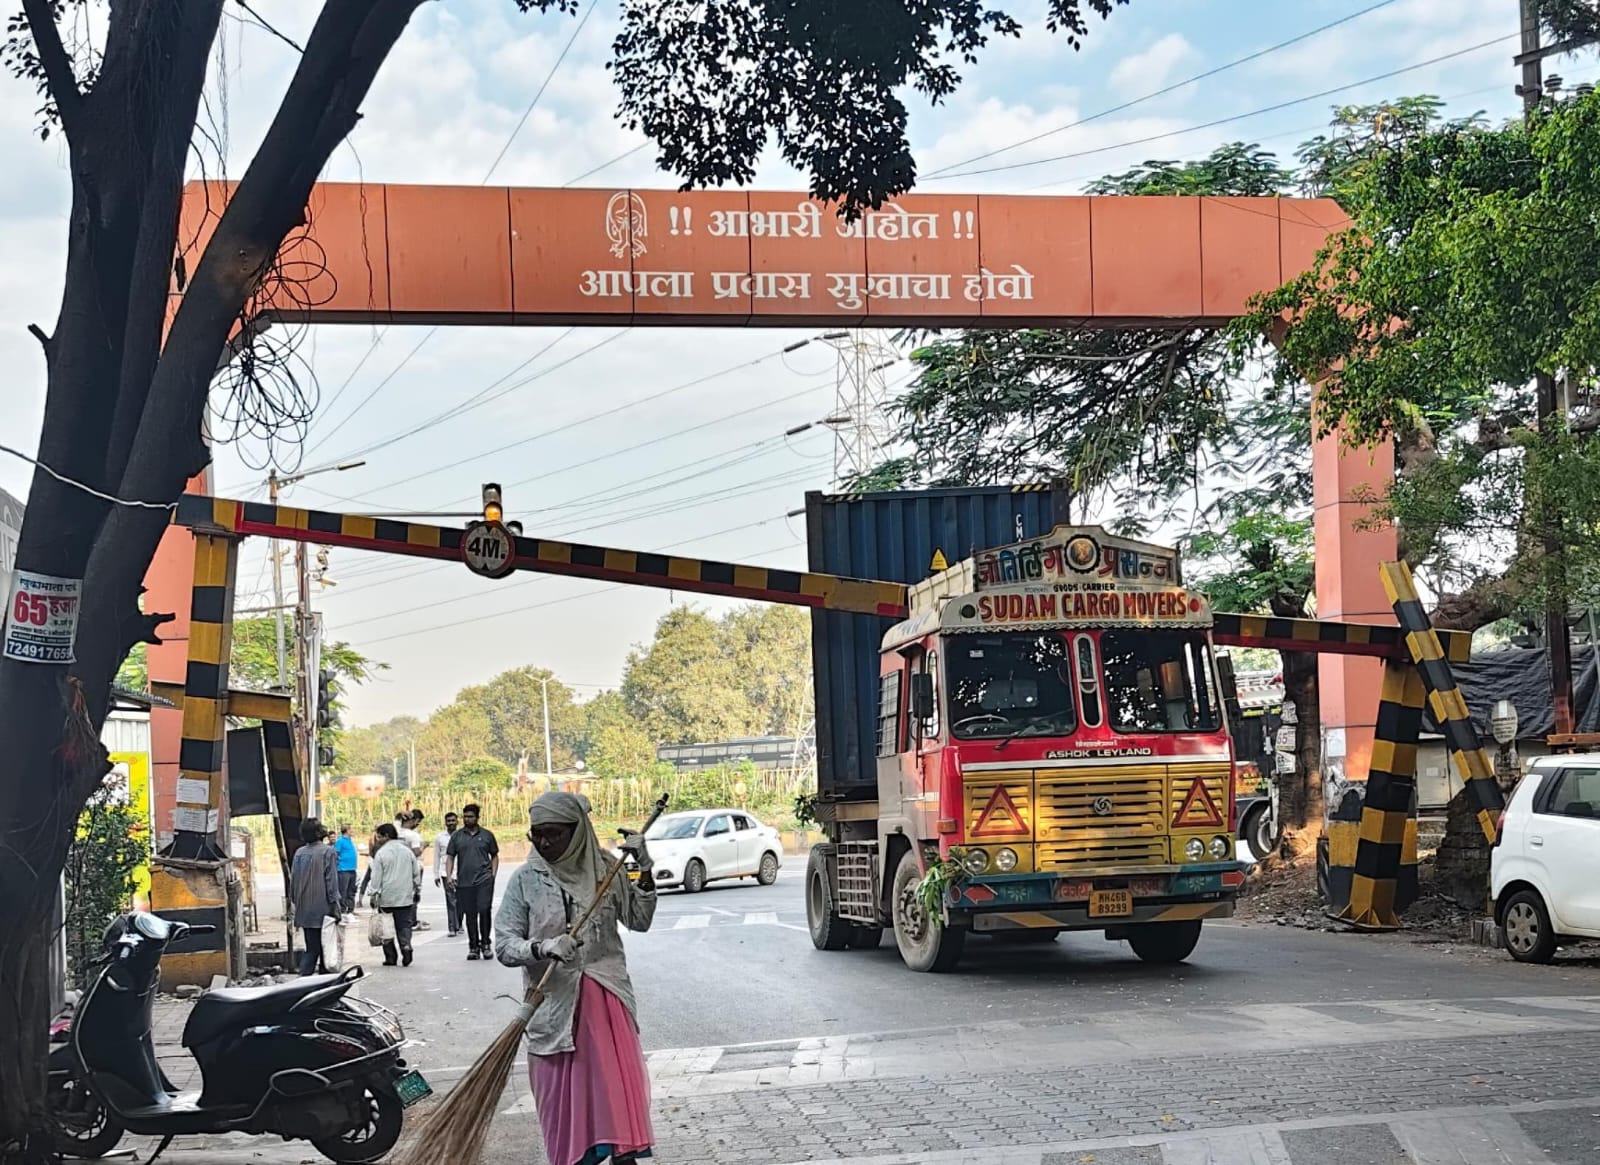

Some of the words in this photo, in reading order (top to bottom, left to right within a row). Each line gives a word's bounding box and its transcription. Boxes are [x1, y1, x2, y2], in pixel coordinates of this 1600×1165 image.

[707, 202, 822, 238] आभारी
[579, 269, 694, 298] आपला
[711, 272, 811, 300] प्रवास
[826, 273, 951, 310] सुखाचा
[962, 264, 1035, 302] होवो
[1015, 513, 1024, 542] CM
[1082, 583, 1116, 591] CARRIER
[14, 591, 47, 626] 65
[978, 594, 1057, 623] SUDAM
[1061, 593, 1121, 620] CARGO
[1122, 592, 1187, 619] MOVERS
[1097, 748, 1151, 756] LEYLAND
